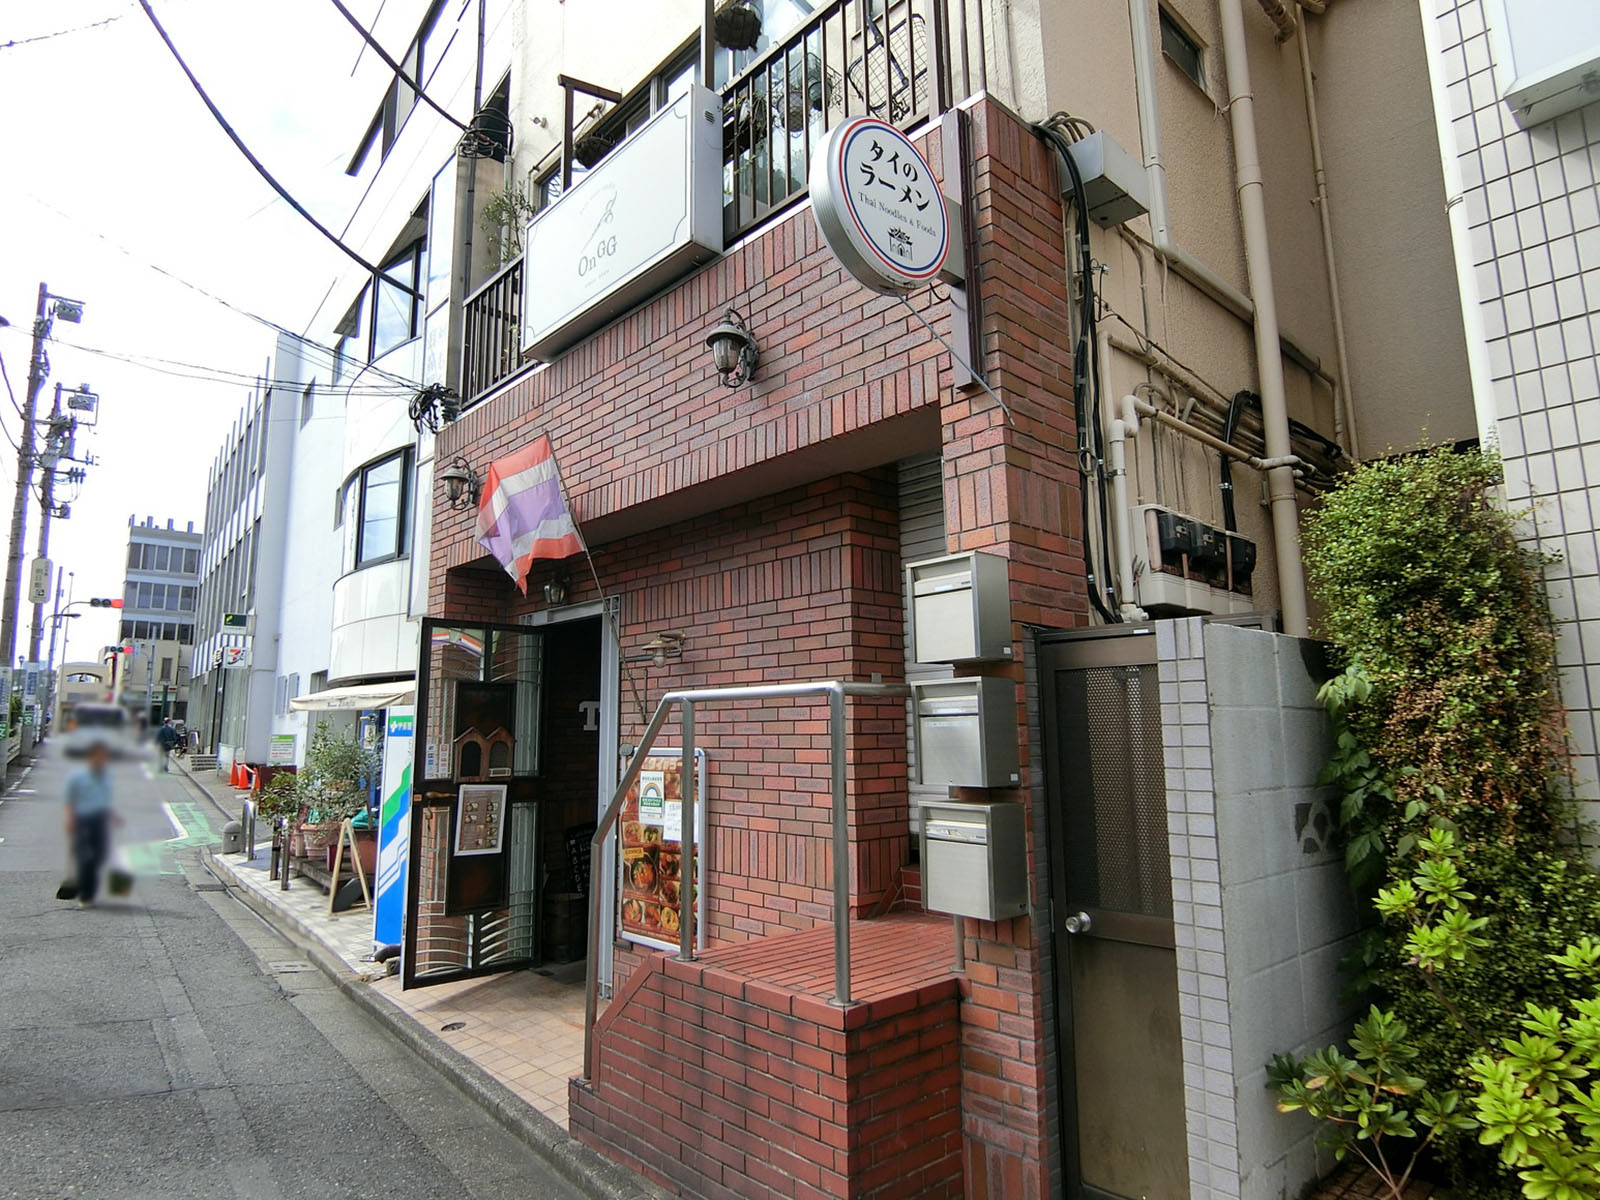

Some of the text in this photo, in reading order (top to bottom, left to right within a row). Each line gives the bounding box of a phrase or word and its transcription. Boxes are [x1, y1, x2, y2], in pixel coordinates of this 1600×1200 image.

[870, 140, 918, 182] タイの
[860, 162, 930, 211] ラーメン
[858, 192, 876, 209] Thai
[879, 202, 907, 222] Noodles
[916, 220, 936, 236] Foods
[579, 702, 600, 731] T
